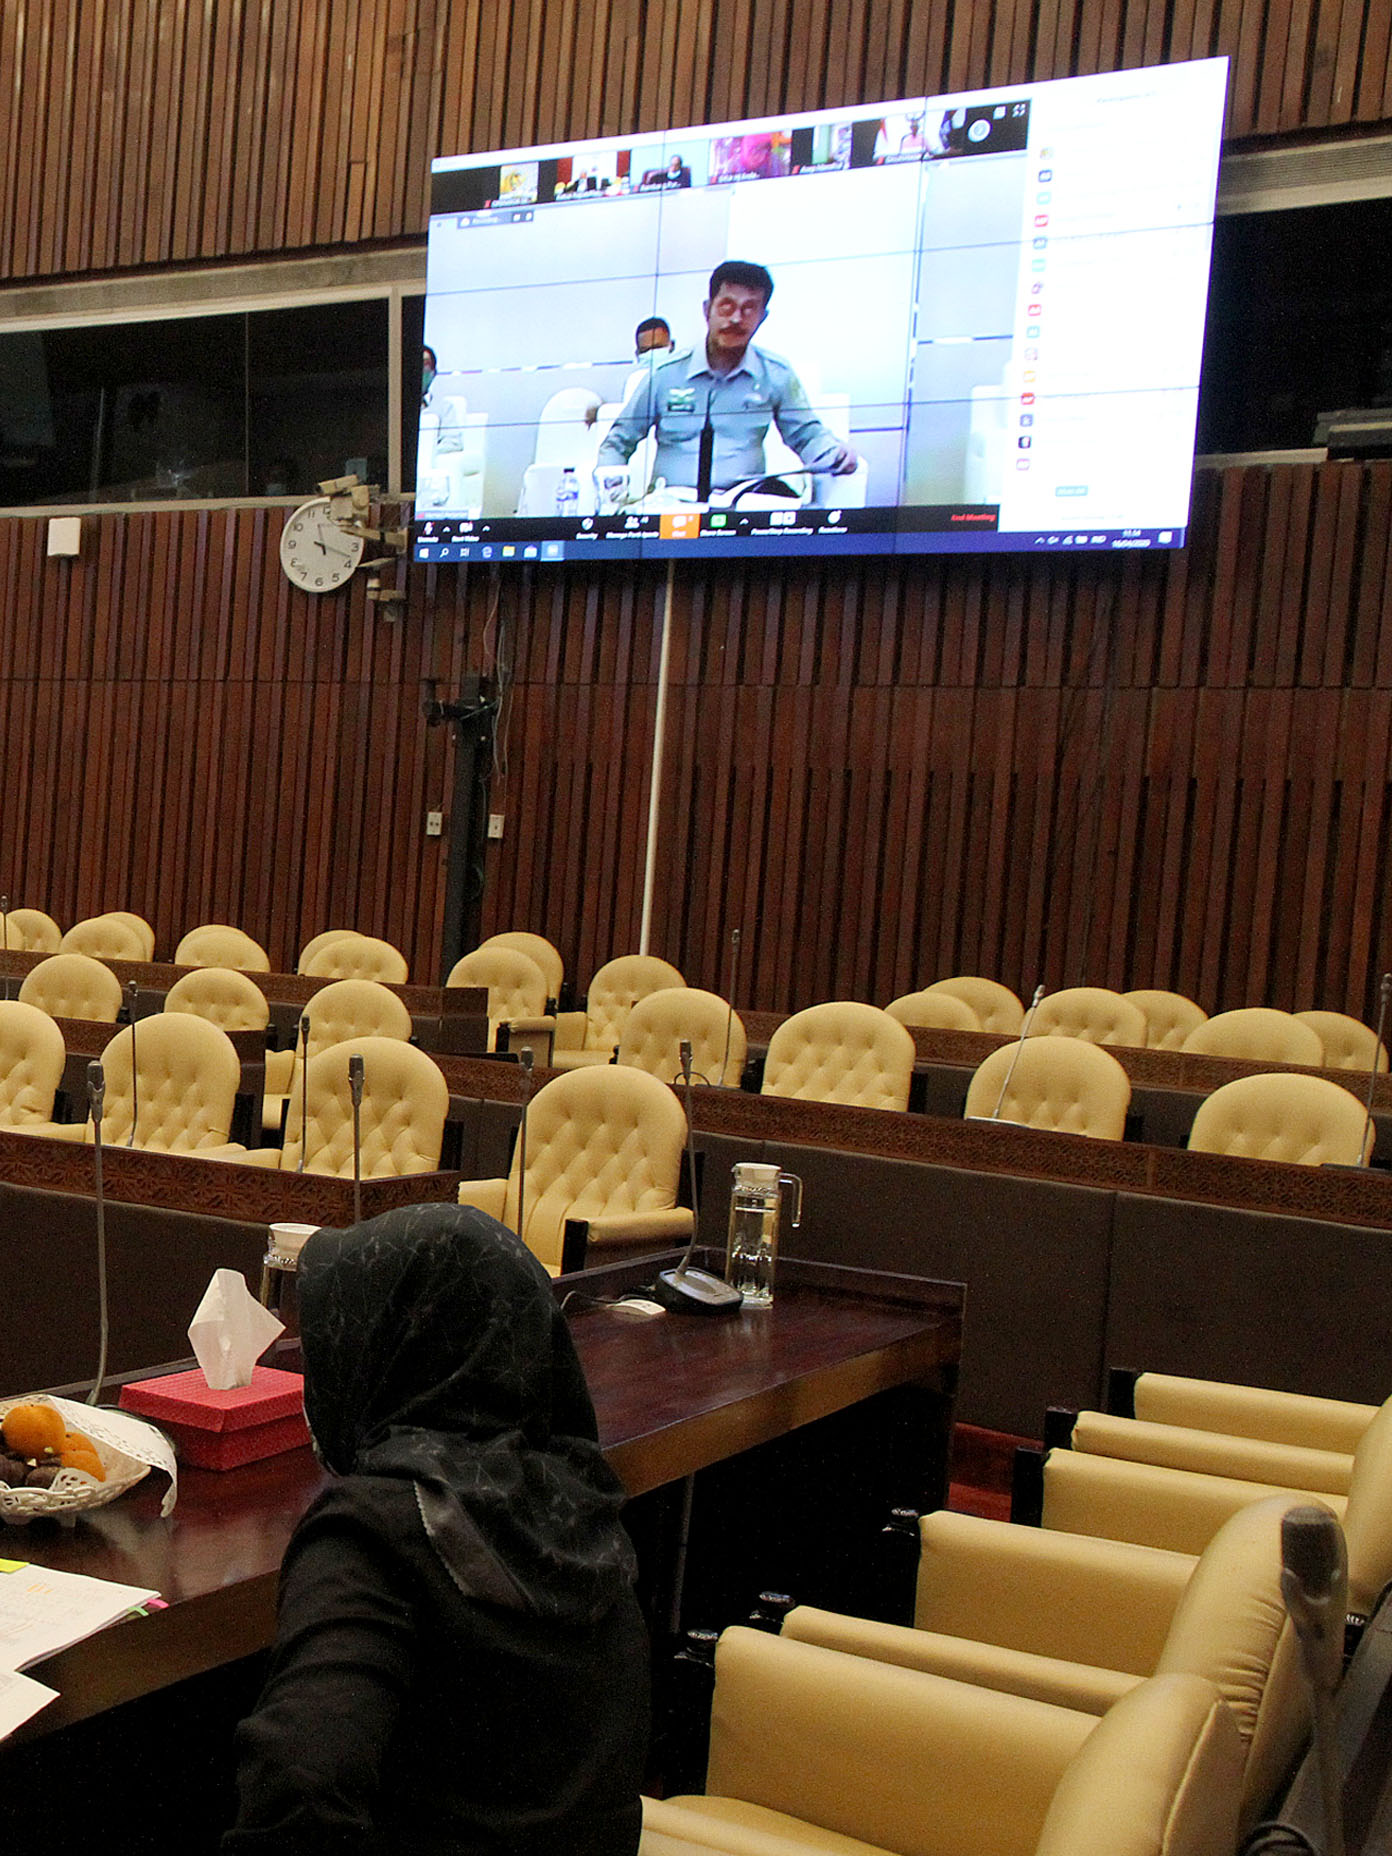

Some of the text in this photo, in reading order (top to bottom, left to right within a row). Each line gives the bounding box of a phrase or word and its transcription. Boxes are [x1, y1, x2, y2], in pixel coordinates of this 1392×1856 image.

[308, 510, 315, 518] 11
[293, 523, 303, 532] 10
[288, 540, 296, 549] 9
[351, 542, 359, 552] 3
[344, 559, 352, 569] 4
[300, 572, 308, 581] 7
[332, 573, 340, 583] 5
[315, 577, 324, 587] 6
